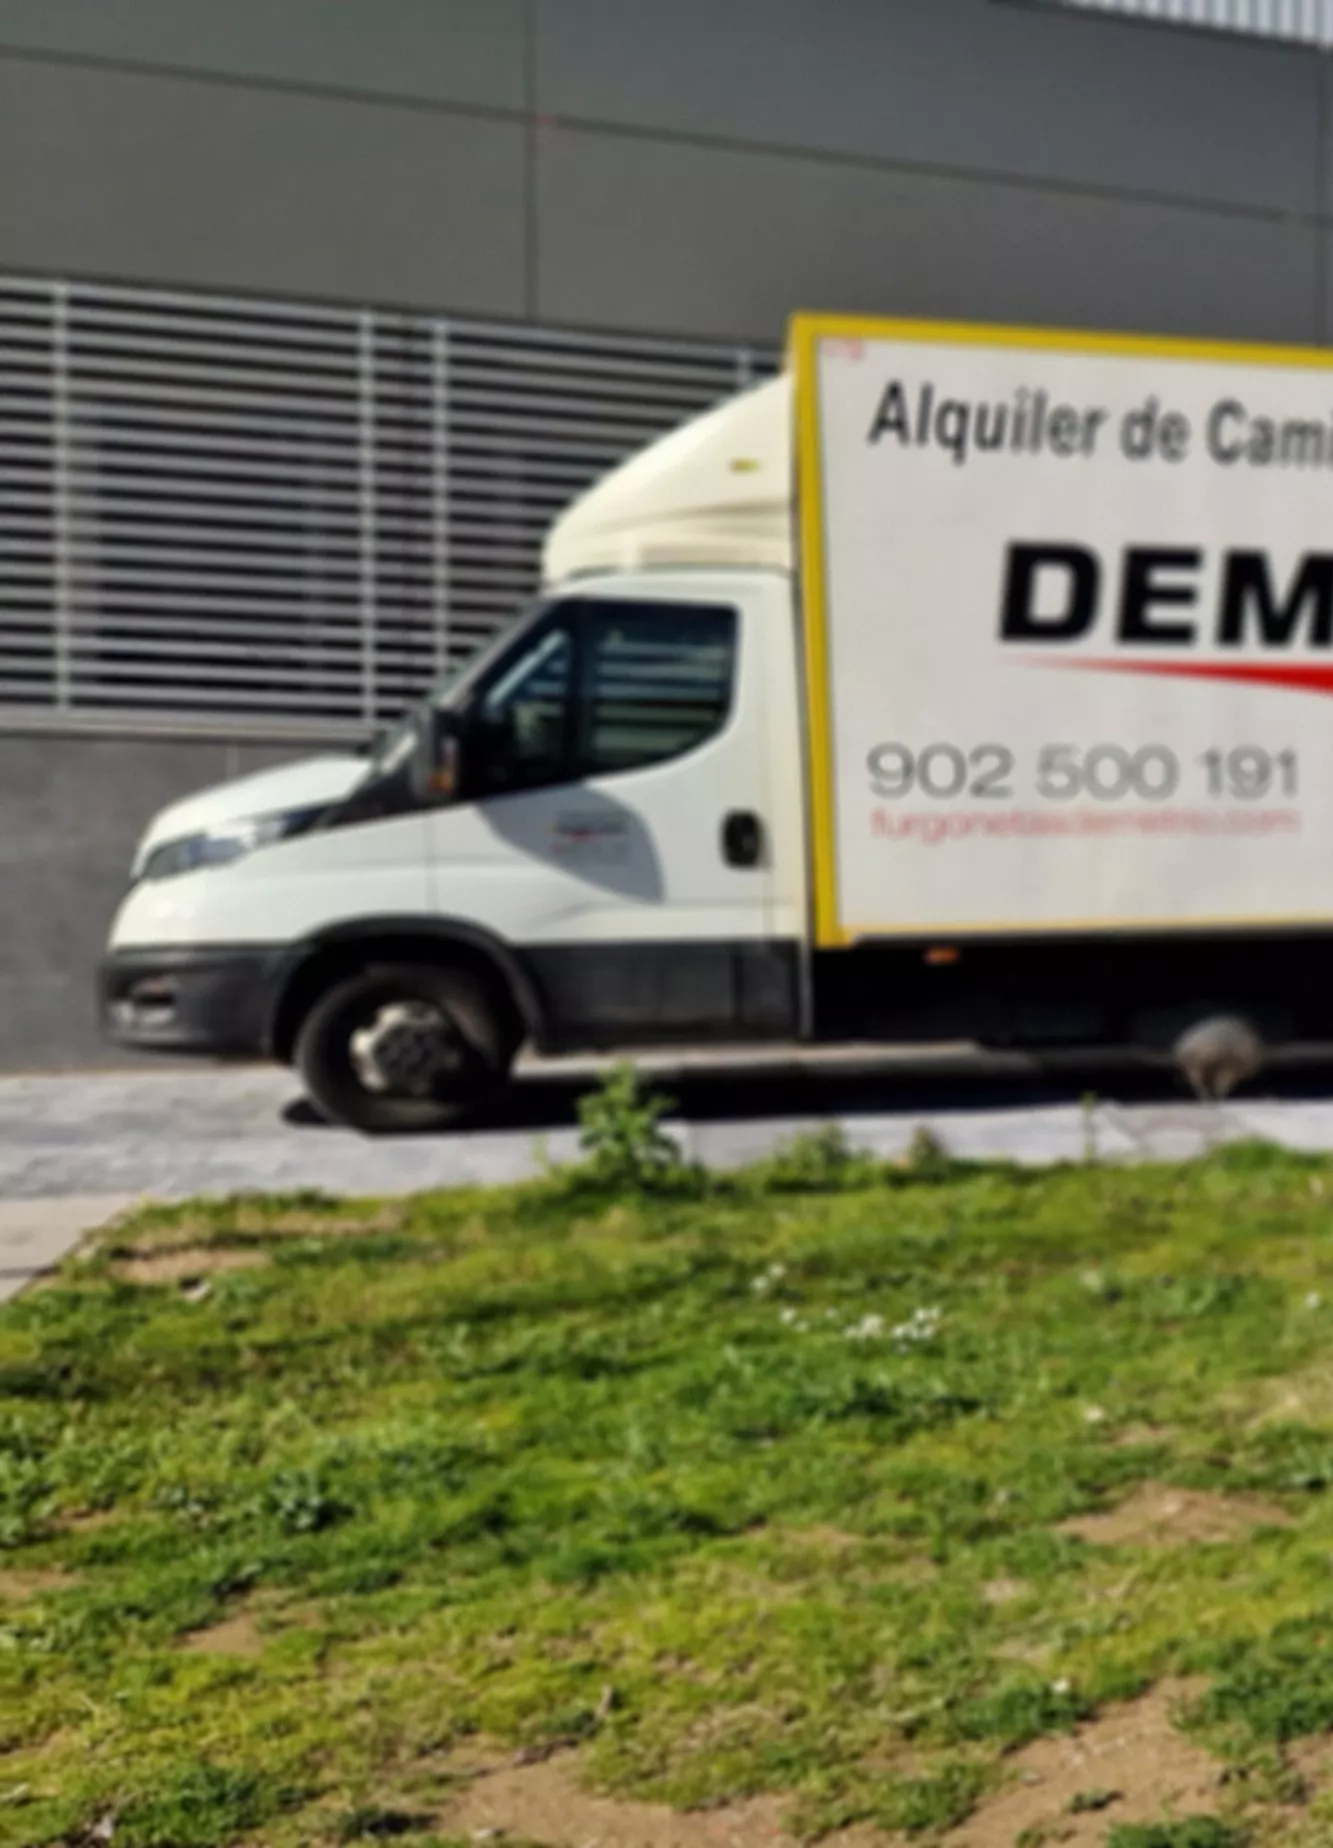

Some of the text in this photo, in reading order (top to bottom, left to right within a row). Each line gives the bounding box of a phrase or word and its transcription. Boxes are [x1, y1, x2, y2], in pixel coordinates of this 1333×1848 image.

[866, 378, 1109, 467] Alquiler
[1117, 392, 1192, 464] de
[865, 740, 1300, 802] 902 500 191
